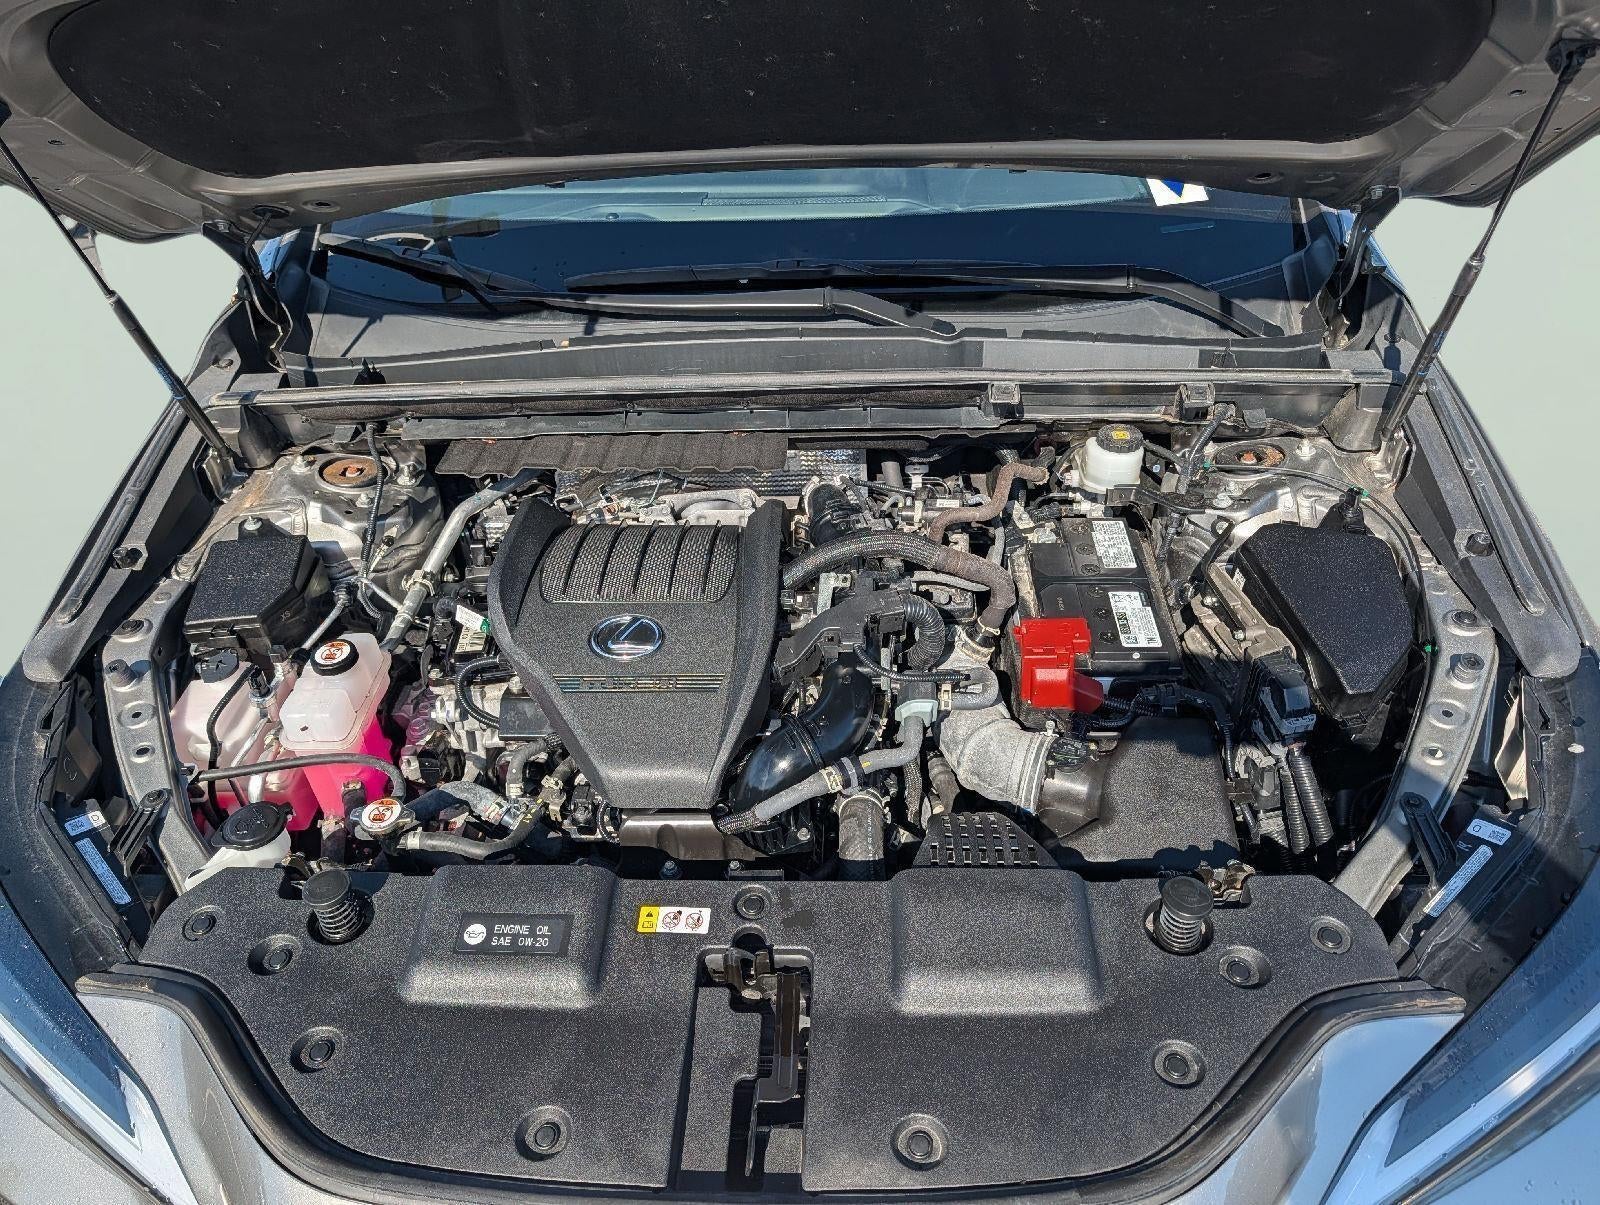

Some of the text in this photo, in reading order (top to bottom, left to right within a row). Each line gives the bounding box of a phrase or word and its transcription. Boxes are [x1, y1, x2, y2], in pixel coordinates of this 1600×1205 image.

[494, 924, 552, 934] ENGINE OIL
[491, 936, 549, 947] SAE 0W-20
